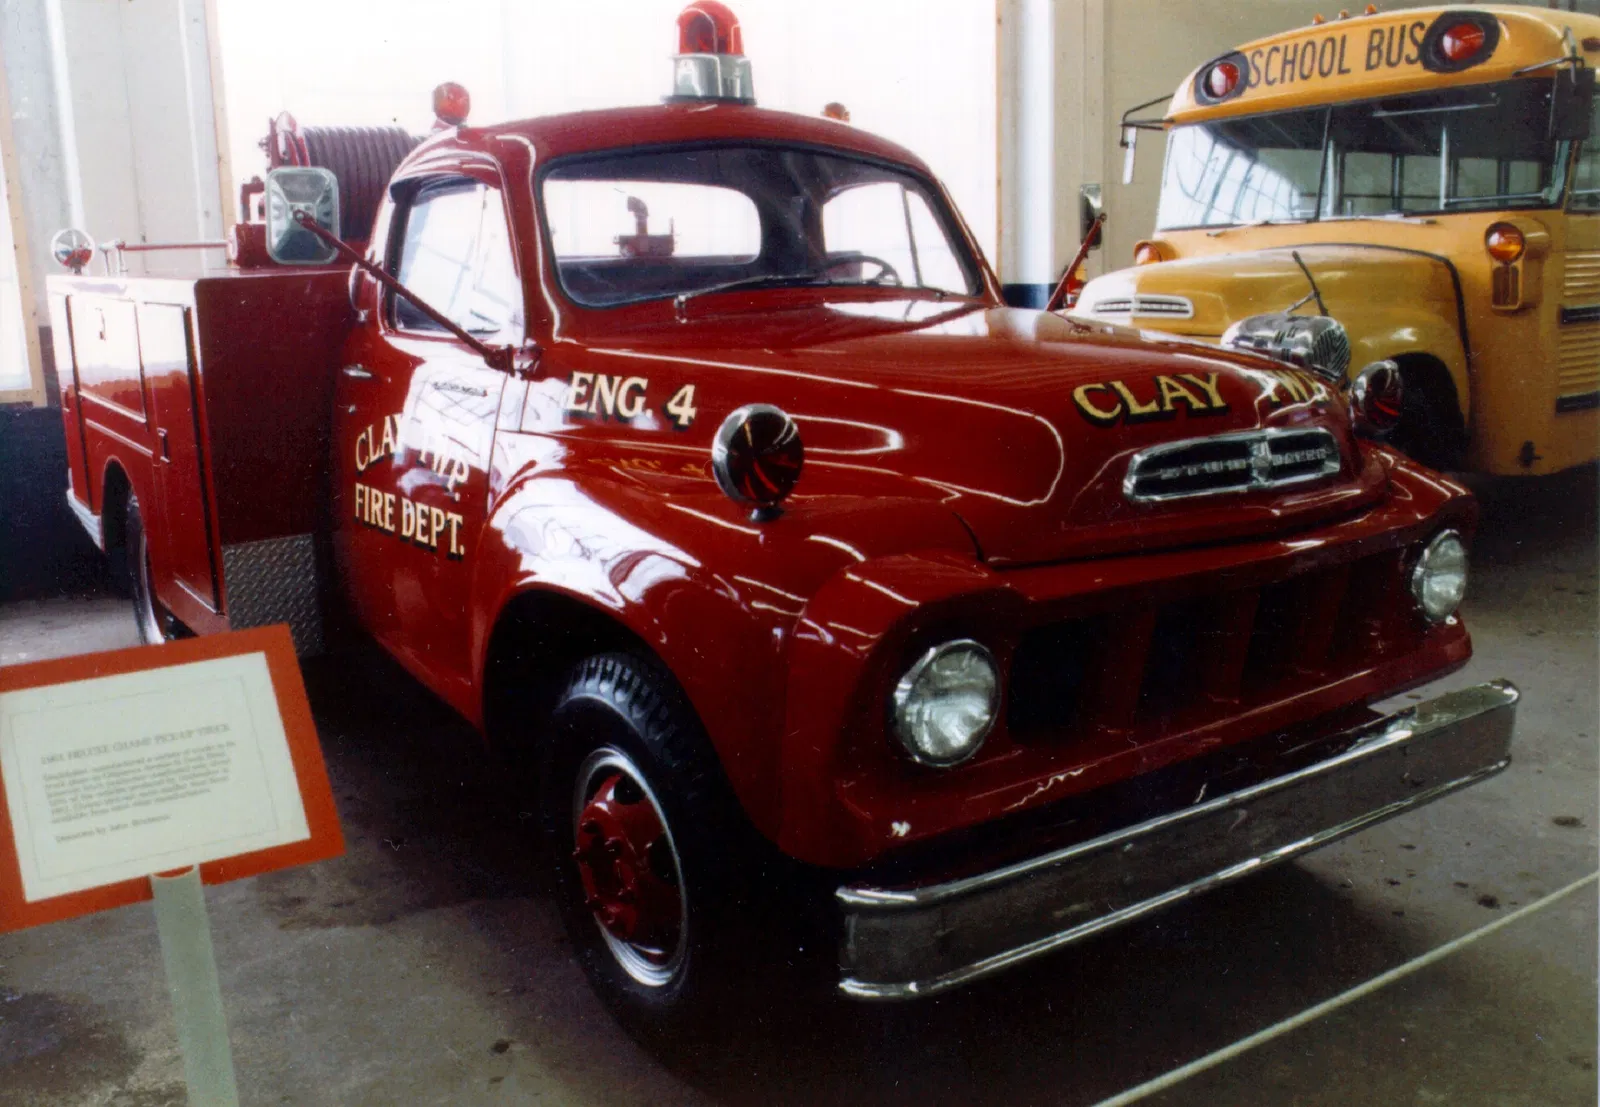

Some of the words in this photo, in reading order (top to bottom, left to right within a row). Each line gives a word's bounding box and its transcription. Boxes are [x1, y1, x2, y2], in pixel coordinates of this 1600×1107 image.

[1248, 36, 1351, 88] SCHOOL
[1365, 21, 1426, 71] BUS
[567, 371, 654, 418] ENG.
[667, 384, 697, 426] 4
[1072, 372, 1227, 421] CLAY
[355, 482, 396, 533] FIRE
[401, 497, 465, 556] DEPT.
